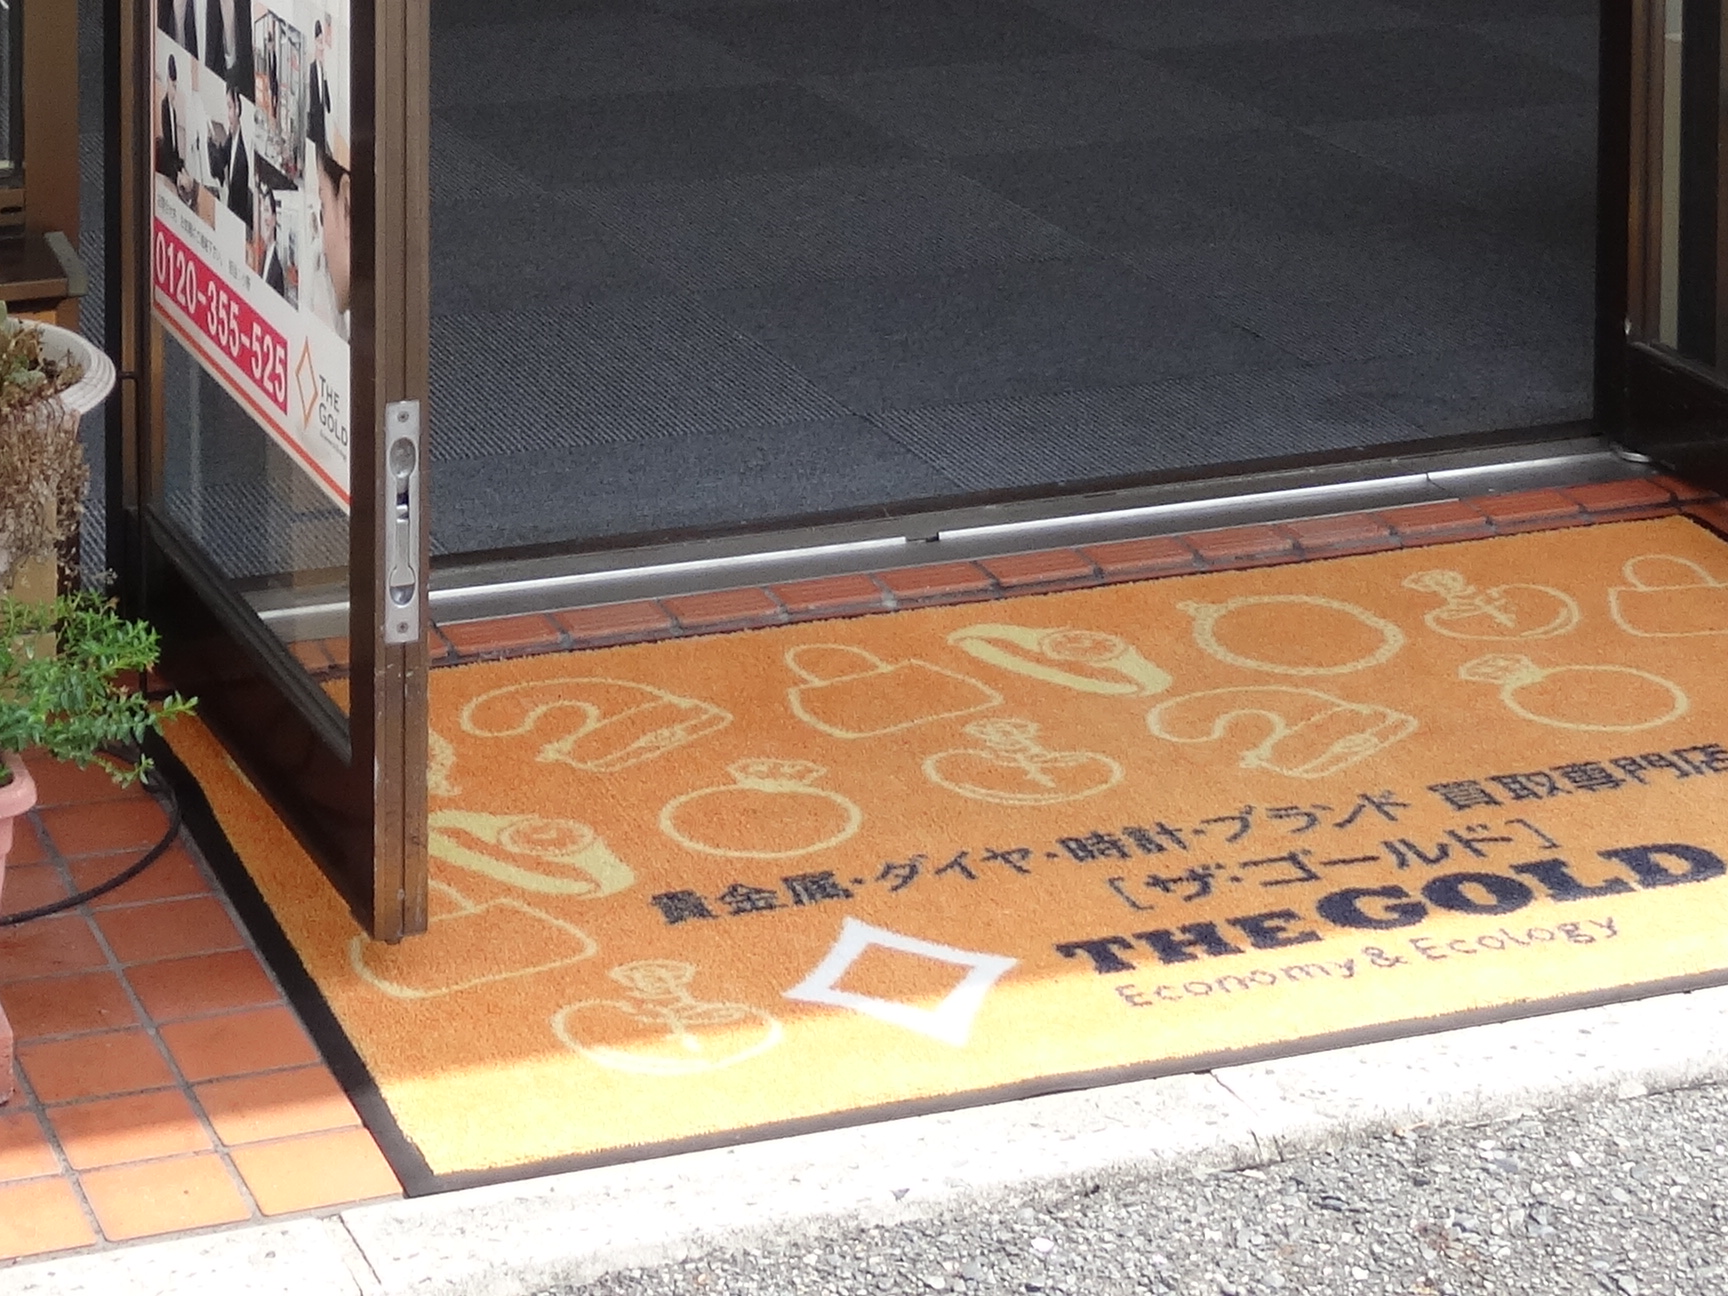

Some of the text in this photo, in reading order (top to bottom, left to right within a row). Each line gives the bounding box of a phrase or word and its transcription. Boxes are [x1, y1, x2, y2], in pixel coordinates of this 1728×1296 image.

[155, 230, 287, 405] 0120-355-525
[319, 373, 340, 413] THE
[318, 401, 349, 447] GOLD
[648, 786, 1411, 926] 貴金属・ダイヤ・時計・ブランド
[1055, 915, 1322, 976] THE
